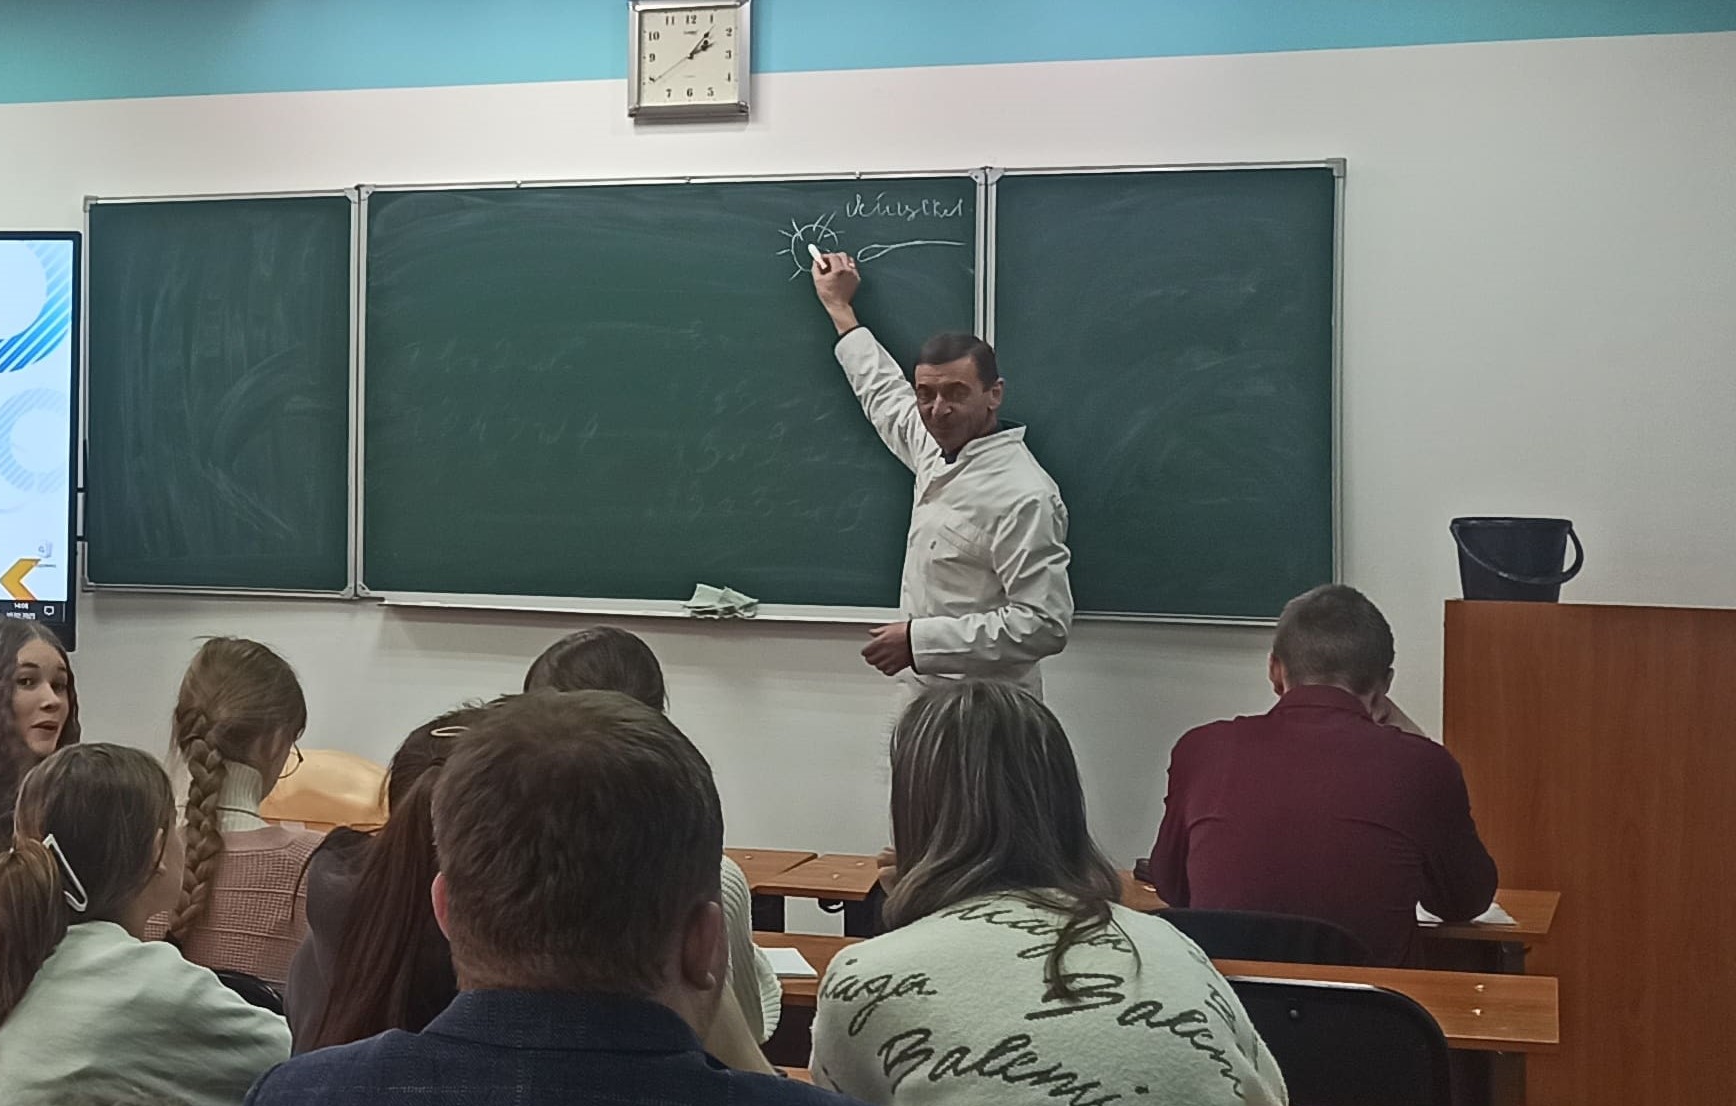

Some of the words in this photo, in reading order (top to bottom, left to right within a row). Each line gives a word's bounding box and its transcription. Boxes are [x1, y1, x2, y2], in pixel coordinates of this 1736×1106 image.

[665, 15, 675, 26] 11
[685, 14, 697, 25] 12
[648, 31, 660, 41] 10
[648, 53, 656, 63] 9
[686, 87, 694, 97] 6
